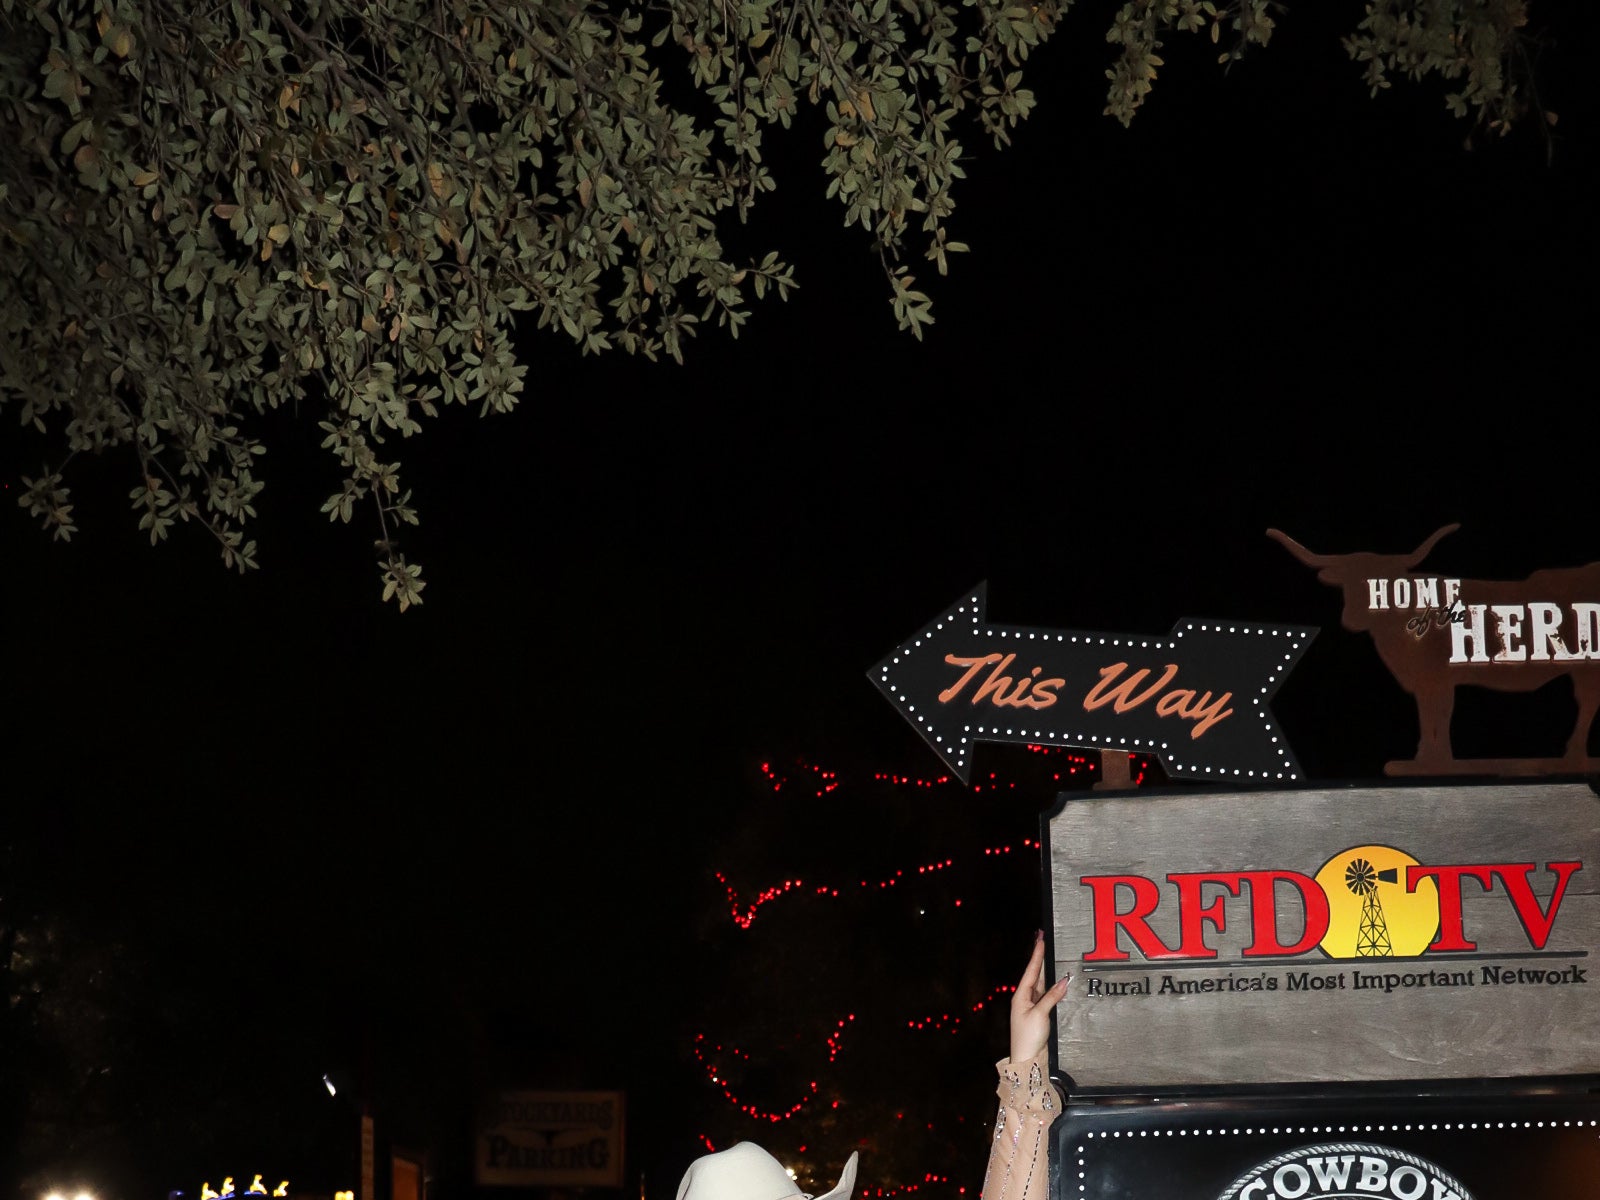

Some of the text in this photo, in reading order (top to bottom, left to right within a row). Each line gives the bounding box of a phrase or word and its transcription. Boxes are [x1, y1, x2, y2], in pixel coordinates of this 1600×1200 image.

[1367, 578, 1462, 609] HOME
[1406, 605, 1432, 641] of
[1449, 602, 1600, 663] HERD
[938, 653, 1235, 740] This Way
[1080, 861, 1583, 963] RFD TV
[1087, 964, 1587, 999] Rural America's Most Important Network
[486, 1134, 610, 1169] PARKING
